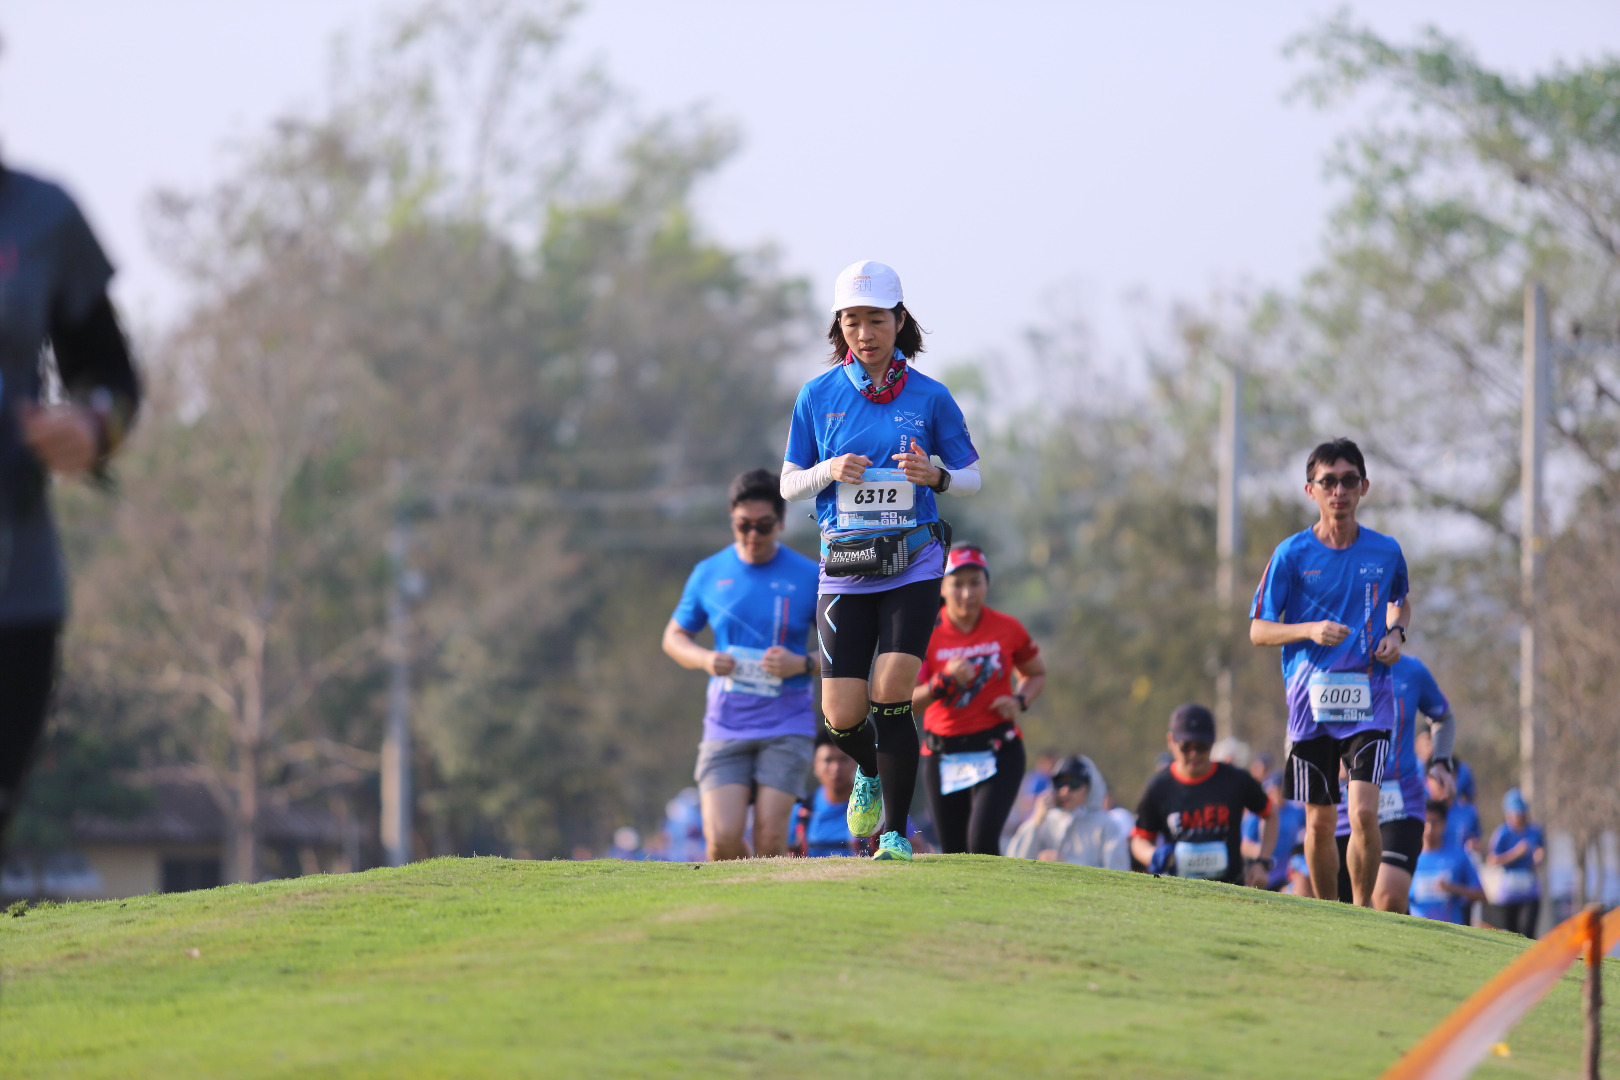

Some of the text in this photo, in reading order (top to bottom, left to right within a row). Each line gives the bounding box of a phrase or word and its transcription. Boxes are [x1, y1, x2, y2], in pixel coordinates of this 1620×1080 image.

[854, 488, 897, 505] 6312
[831, 553, 877, 563] DIRECTION
[833, 546, 876, 559] ULTIMATE
[1319, 688, 1361, 704] 6003
